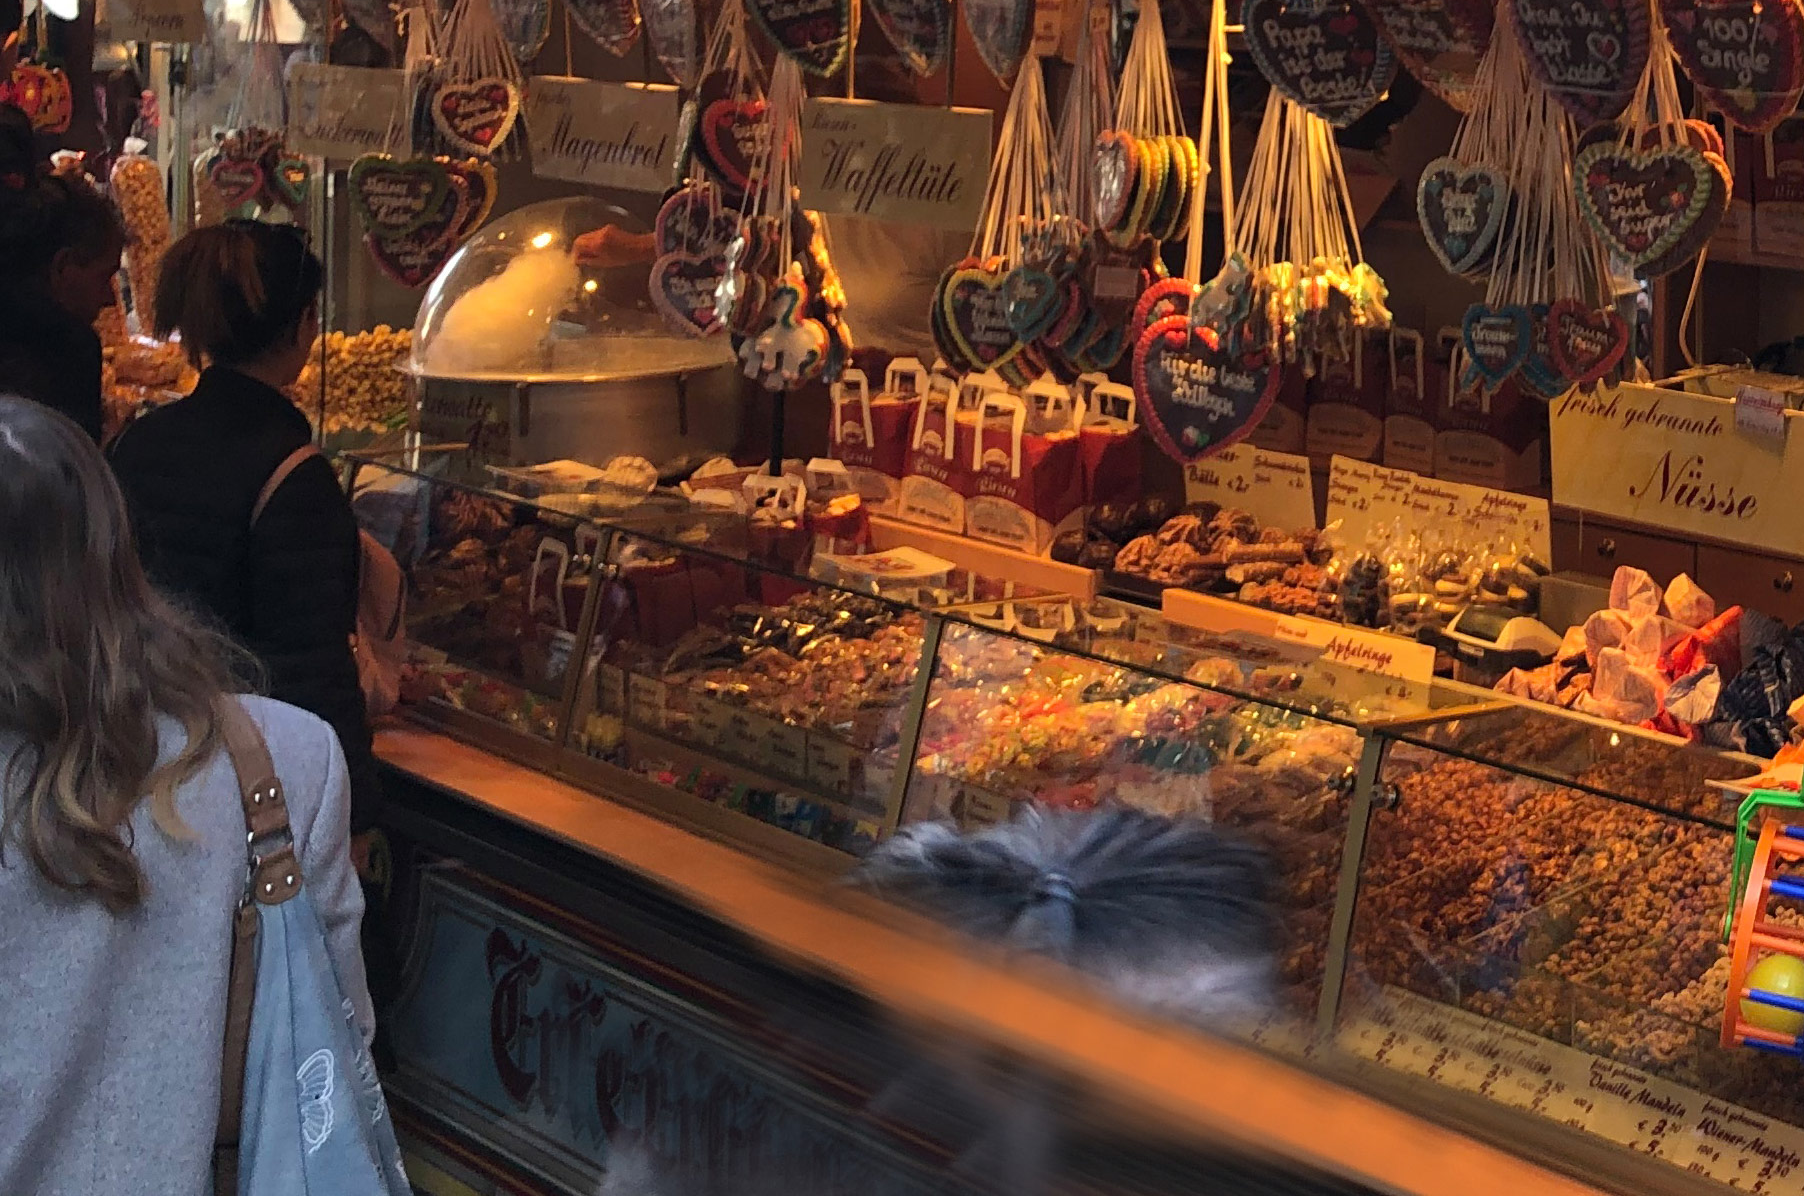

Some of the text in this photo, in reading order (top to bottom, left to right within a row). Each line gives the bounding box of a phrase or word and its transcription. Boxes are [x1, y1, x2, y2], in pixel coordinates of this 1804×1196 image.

[1263, 19, 1325, 54] Papa
[1622, 399, 1724, 437] gebrannte
[1628, 449, 1758, 519] Nüsse
